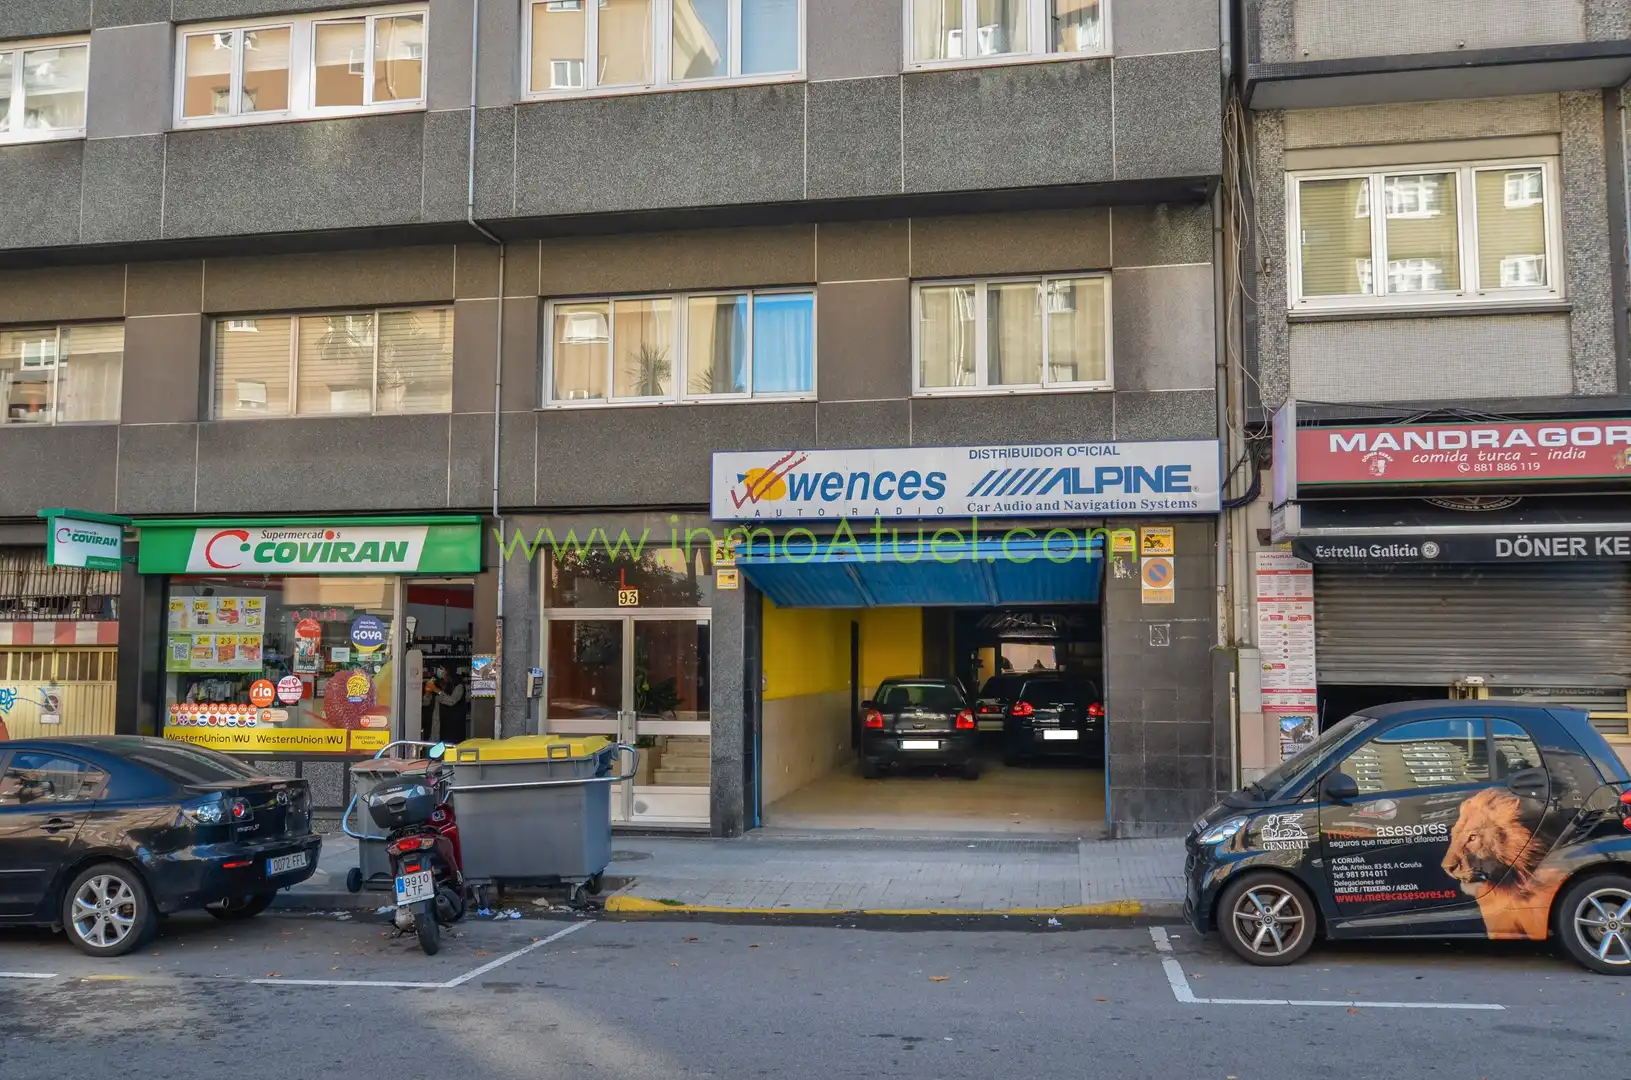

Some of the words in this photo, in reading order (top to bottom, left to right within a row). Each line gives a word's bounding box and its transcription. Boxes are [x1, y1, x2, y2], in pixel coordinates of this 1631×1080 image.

[1329, 425, 1631, 453] MANDRAGOR
[969, 446, 1063, 460] DISTRIBUIDOR
[1066, 445, 1121, 457] OFICIAL
[1412, 449, 1468, 463] comida
[1477, 450, 1521, 462] turca
[1547, 447, 1586, 461] india
[1473, 463, 1494, 473] 881
[1496, 463, 1518, 472] 886
[1521, 462, 1541, 472] 119
[788, 470, 947, 501] wences
[1036, 464, 1192, 496] ALPINE
[966, 502, 991, 513] Car
[993, 501, 1032, 513] Audio
[1035, 500, 1061, 511] and
[1063, 498, 1137, 514] Navigation
[1140, 498, 1198, 511] Systems
[71, 532, 118, 547] COVIRAN
[1495, 534, 1588, 558] DÖNER
[253, 541, 410, 564] COVIRAN
[1315, 545, 1367, 559] Estrella
[1369, 544, 1418, 558] Galicia
[619, 591, 638, 605] 93
[352, 630, 383, 641] GOYA
[252, 684, 272, 698] ria
[234, 735, 250, 743] WU
[326, 736, 344, 745] WU
[1376, 823, 1448, 838] asesores
[1262, 840, 1310, 851] GENERALI
[1329, 840, 1360, 849] seguros
[1361, 839, 1376, 848] que
[1377, 837, 1405, 846] marcan
[1405, 836, 1413, 844] la
[1414, 835, 1449, 844] diferencia
[273, 856, 292, 870] 0072
[292, 853, 306, 867] FFL
[1337, 856, 1366, 864] CORUÑA
[1399, 861, 1422, 869] Coruña
[404, 873, 430, 888] 9910
[1345, 871, 1360, 879] 981
[405, 884, 424, 897] LTF
[1334, 886, 1359, 894] MELIDE
[1363, 885, 1392, 893] TEIXEIRO
[1396, 883, 1419, 891] ARZÚA
[1335, 889, 1457, 903] www.metecasesores.es
